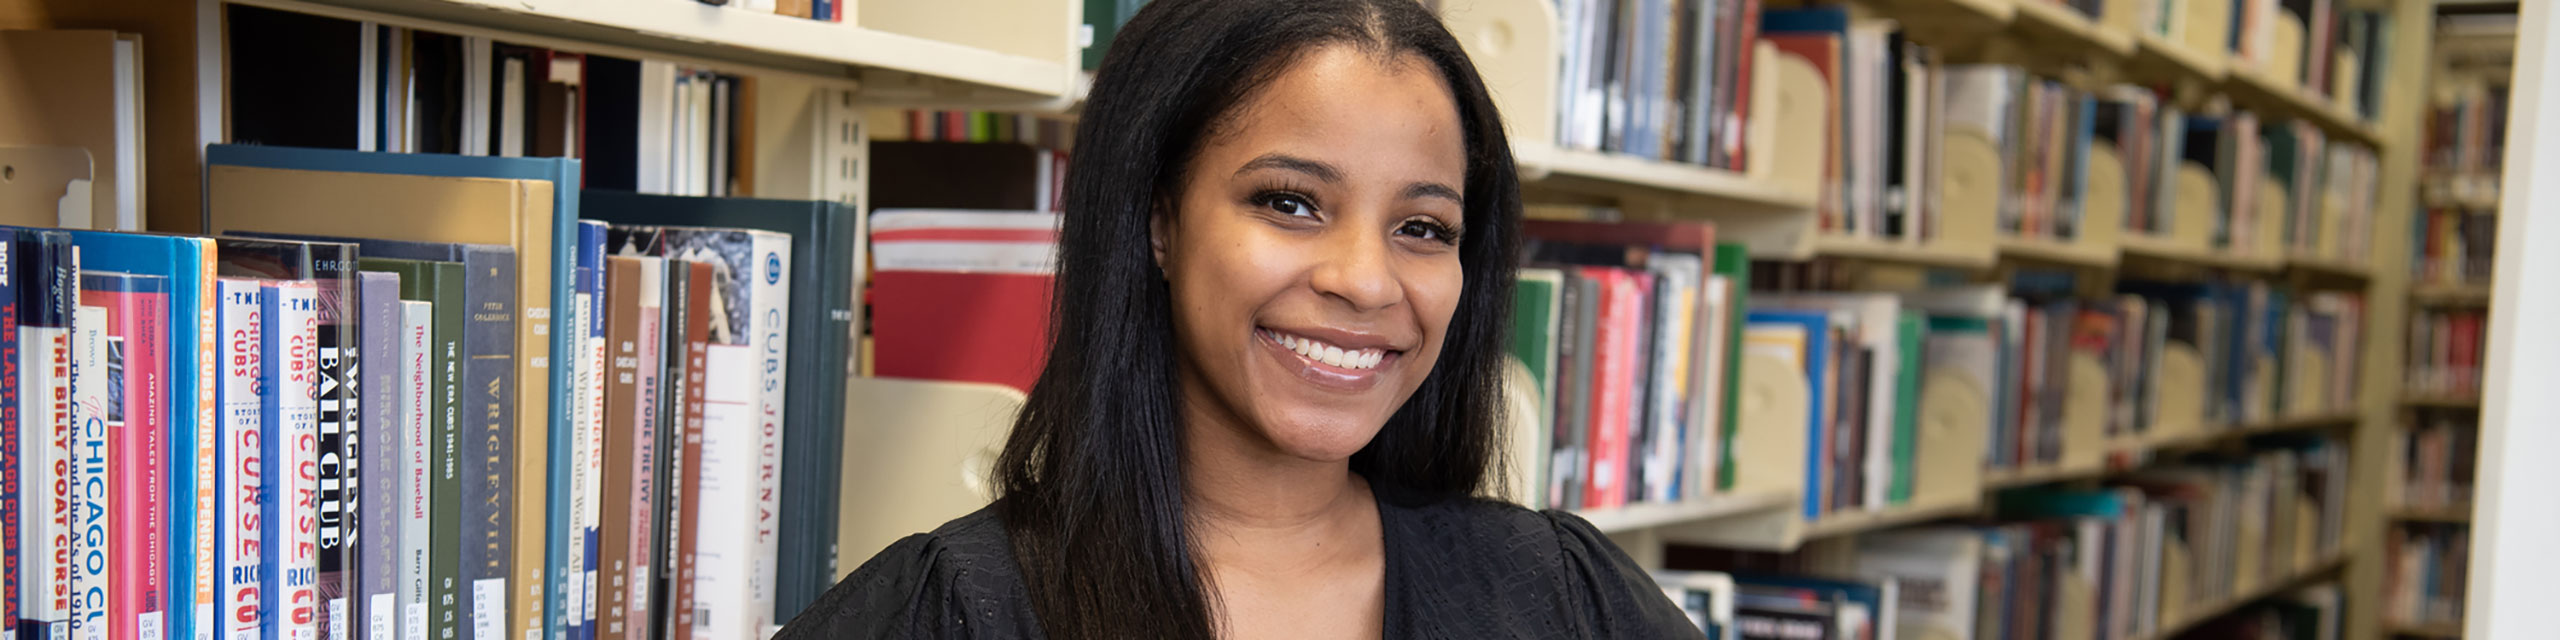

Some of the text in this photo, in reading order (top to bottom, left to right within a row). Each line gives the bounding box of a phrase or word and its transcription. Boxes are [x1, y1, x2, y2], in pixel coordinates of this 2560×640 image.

[52, 266, 67, 314] Bogen
[567, 288, 575, 315] CUBS:
[3, 302, 15, 342] THE
[203, 308, 213, 343] THE
[89, 329, 97, 367] Brown
[234, 330, 247, 377] CUBS
[249, 312, 260, 395] CHICAGO
[290, 335, 303, 382] CUBS
[306, 317, 316, 400] CHICAGO
[447, 341, 455, 358] THE
[765, 308, 780, 393] CUBS
[3, 348, 16, 402] LAST
[202, 350, 213, 401] CUBS
[447, 361, 455, 382] NEW
[577, 370, 588, 416] When
[591, 346, 604, 469] NORTHSIDERS
[643, 376, 654, 438] BEFORE
[72, 402, 80, 446] Cubs
[201, 407, 212, 448] WIN
[413, 324, 424, 519] The Neighborhood of Baseball
[576, 420, 585, 446] the
[4, 406, 16, 493] CHICAGO
[320, 347, 340, 549] BALL CLUB
[642, 445, 652, 474] THE
[54, 334, 67, 611] THE BILLY GOAT CURSE
[72, 454, 81, 486] and
[200, 455, 211, 490] THE
[380, 375, 390, 590] MIRACLE COLLAPSE
[575, 450, 585, 491] Cubs
[759, 403, 775, 544] JOURNAL
[72, 495, 81, 523] the
[86, 416, 104, 576] CHICAGO
[243, 430, 260, 558] CURSE
[298, 434, 316, 560] CURSE
[574, 496, 583, 531] Won
[640, 480, 650, 505] IVY
[5, 499, 16, 550] CUBS
[73, 531, 81, 557] A's
[573, 536, 581, 546] It
[73, 564, 83, 582] of
[414, 549, 422, 574] Barry
[573, 552, 581, 573] All
[72, 591, 82, 630] 1910
[442, 594, 453, 606] 875
